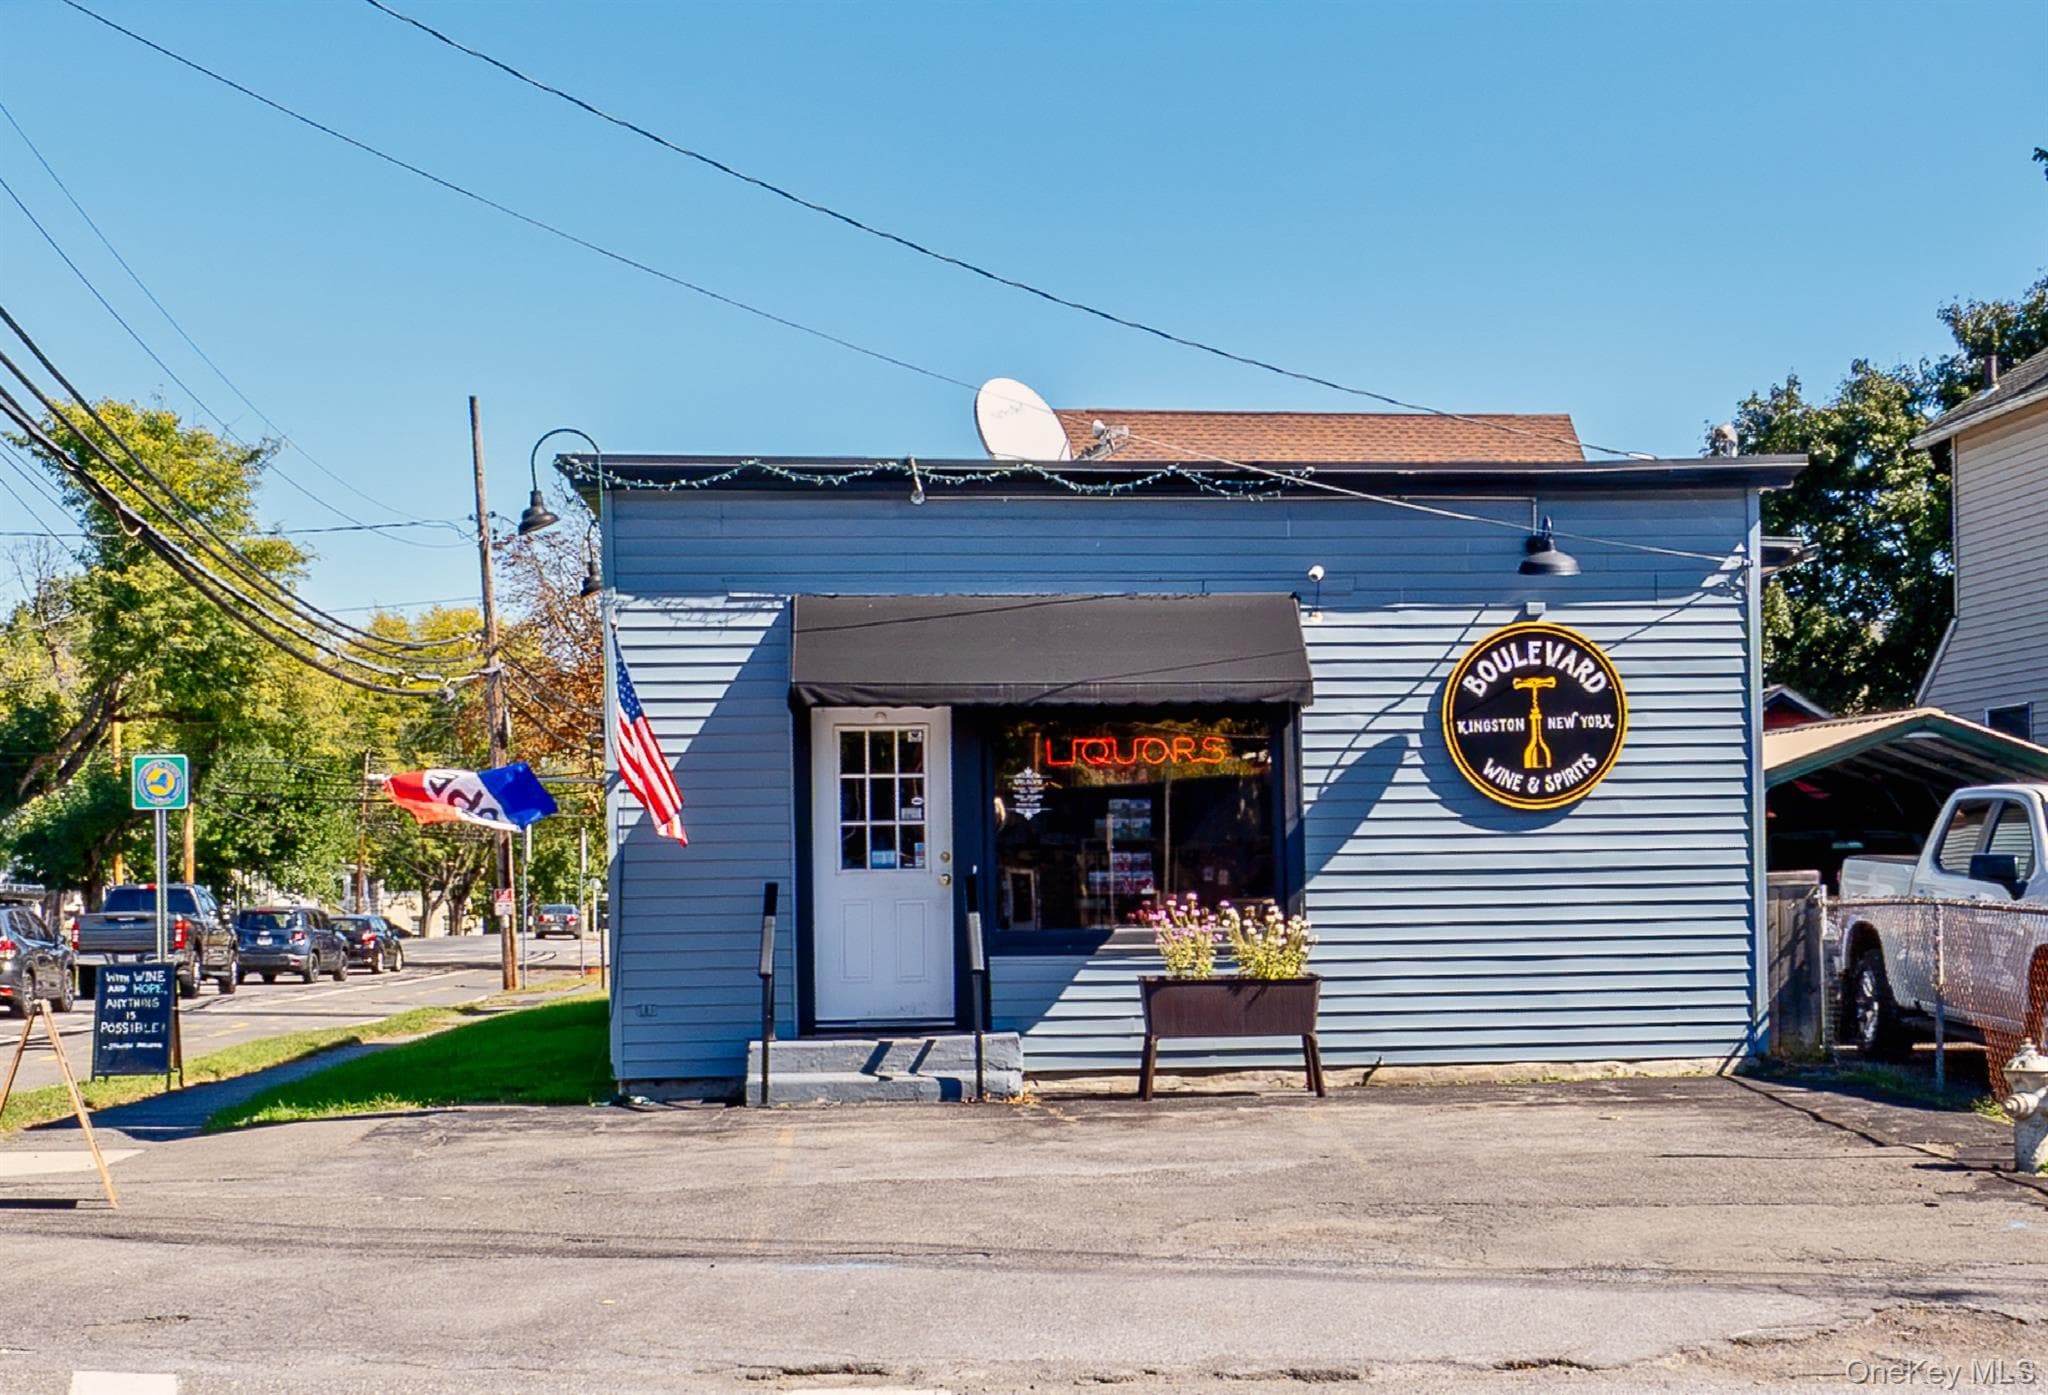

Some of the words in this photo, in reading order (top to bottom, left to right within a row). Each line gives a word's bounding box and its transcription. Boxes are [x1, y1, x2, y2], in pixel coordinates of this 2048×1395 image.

[1462, 641, 1608, 697] BOULEVARD
[1456, 717, 1525, 735] KINGSTON
[1547, 711, 1579, 730] NEW
[1579, 714, 1615, 729] YORK
[1046, 736, 1226, 766] LIQUORS
[1483, 757, 1524, 792] WINE
[1527, 777, 1540, 794] &
[1545, 752, 1598, 793] SPIRITS
[133, 970, 166, 983] WINE
[105, 997, 160, 1009] ANYTHING
[126, 1011, 137, 1020] IS
